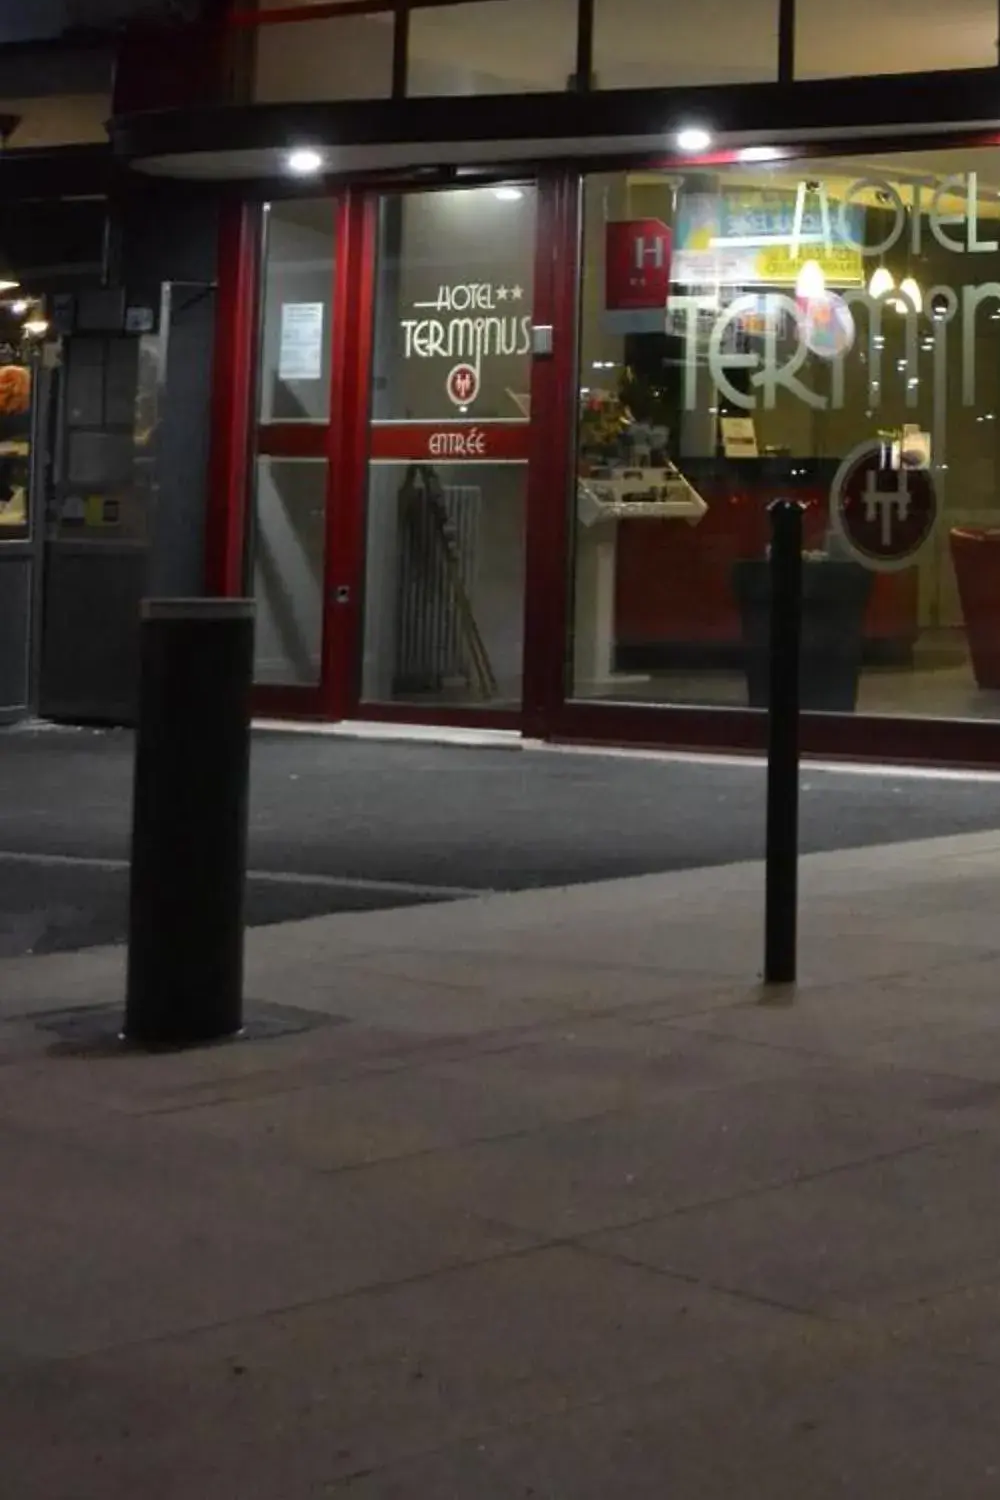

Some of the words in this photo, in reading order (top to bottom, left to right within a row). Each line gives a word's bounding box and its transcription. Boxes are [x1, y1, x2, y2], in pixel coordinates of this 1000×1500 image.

[708, 172, 999, 260] HOTEL
[634, 235, 665, 269] H
[413, 283, 496, 312] HOTEL
[401, 316, 531, 360] TERMINUS
[428, 426, 487, 455] ENTRÉE
